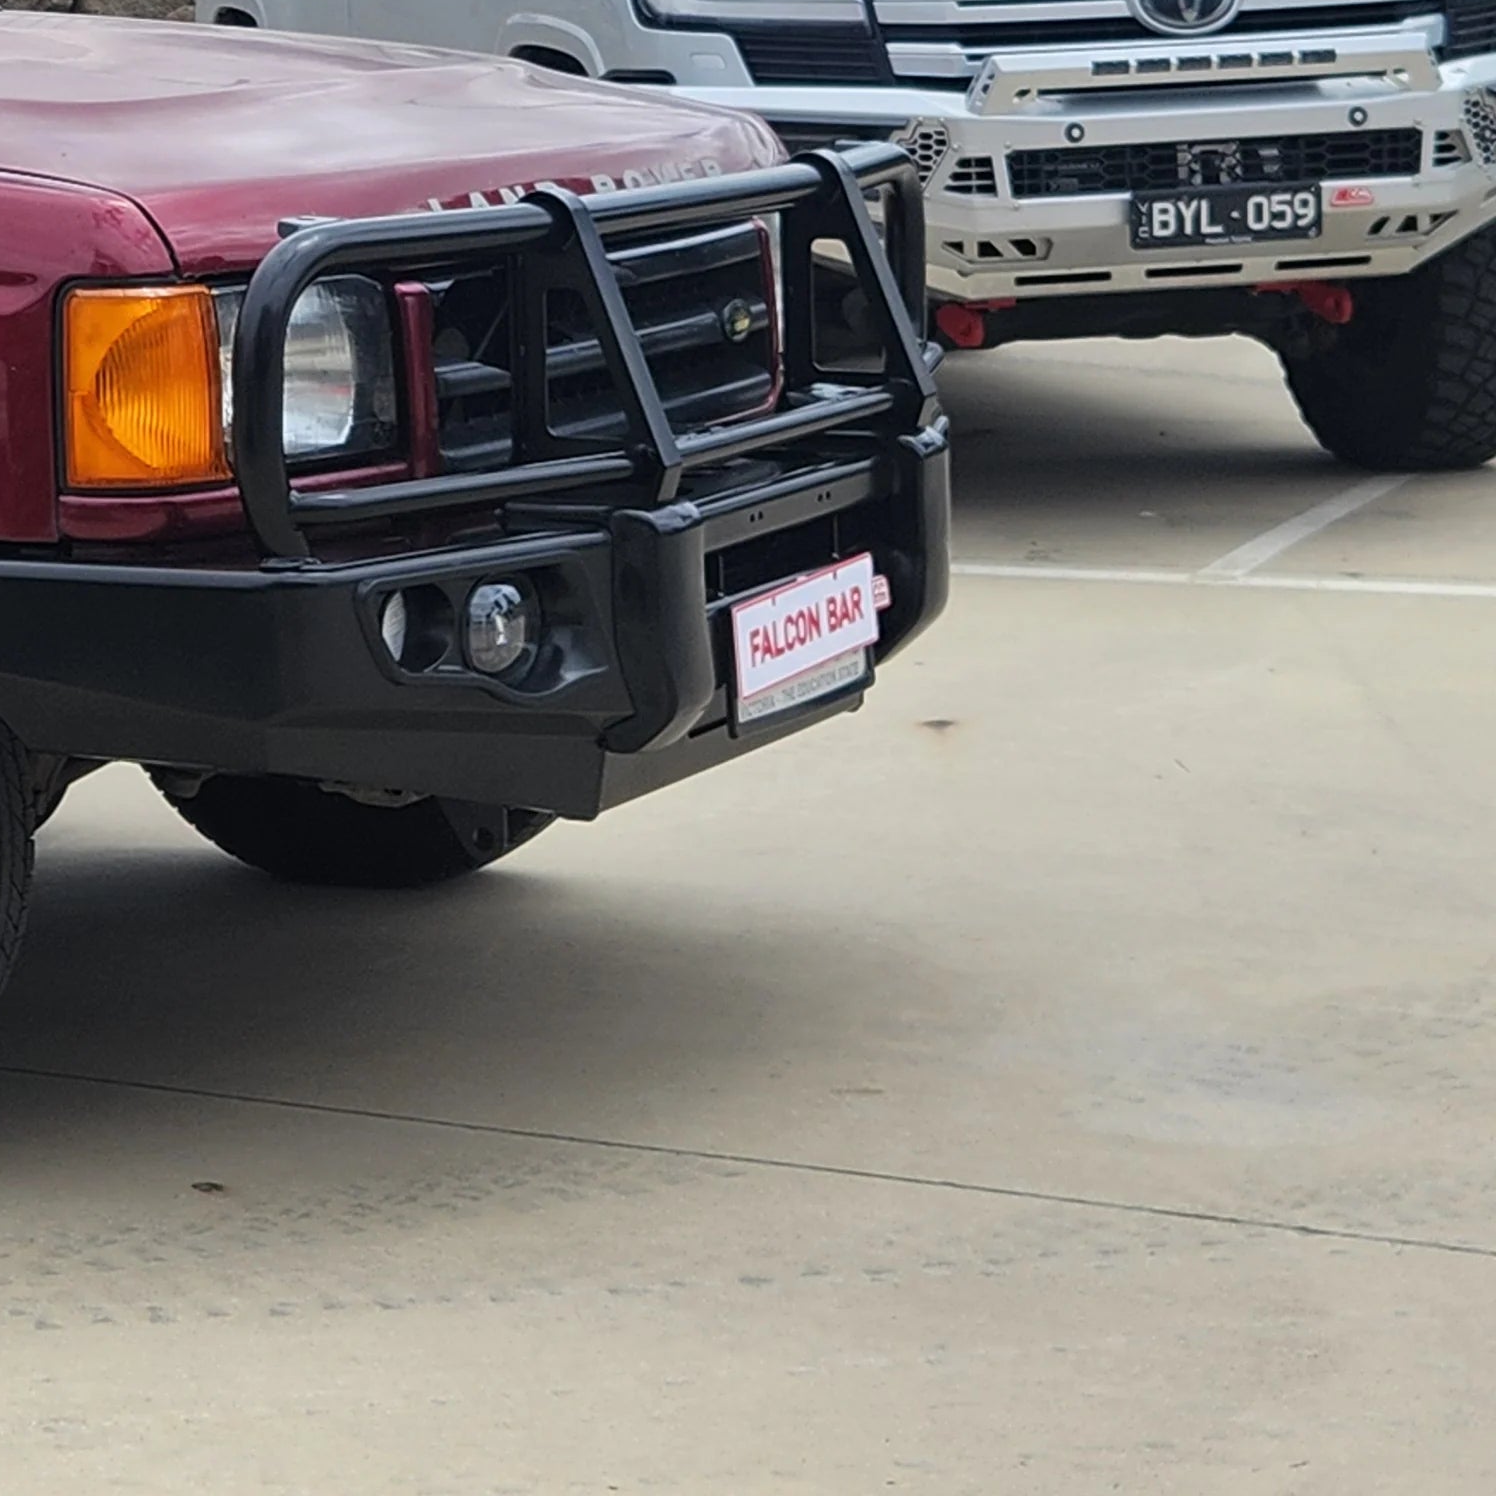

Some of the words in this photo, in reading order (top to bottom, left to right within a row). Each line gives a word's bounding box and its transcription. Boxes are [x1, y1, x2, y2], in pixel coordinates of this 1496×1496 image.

[1137, 201, 1150, 237] VIC
[1152, 199, 1224, 237] BYL
[1247, 192, 1315, 231] 059
[749, 602, 822, 668] FALCON
[826, 585, 864, 633] BAR
